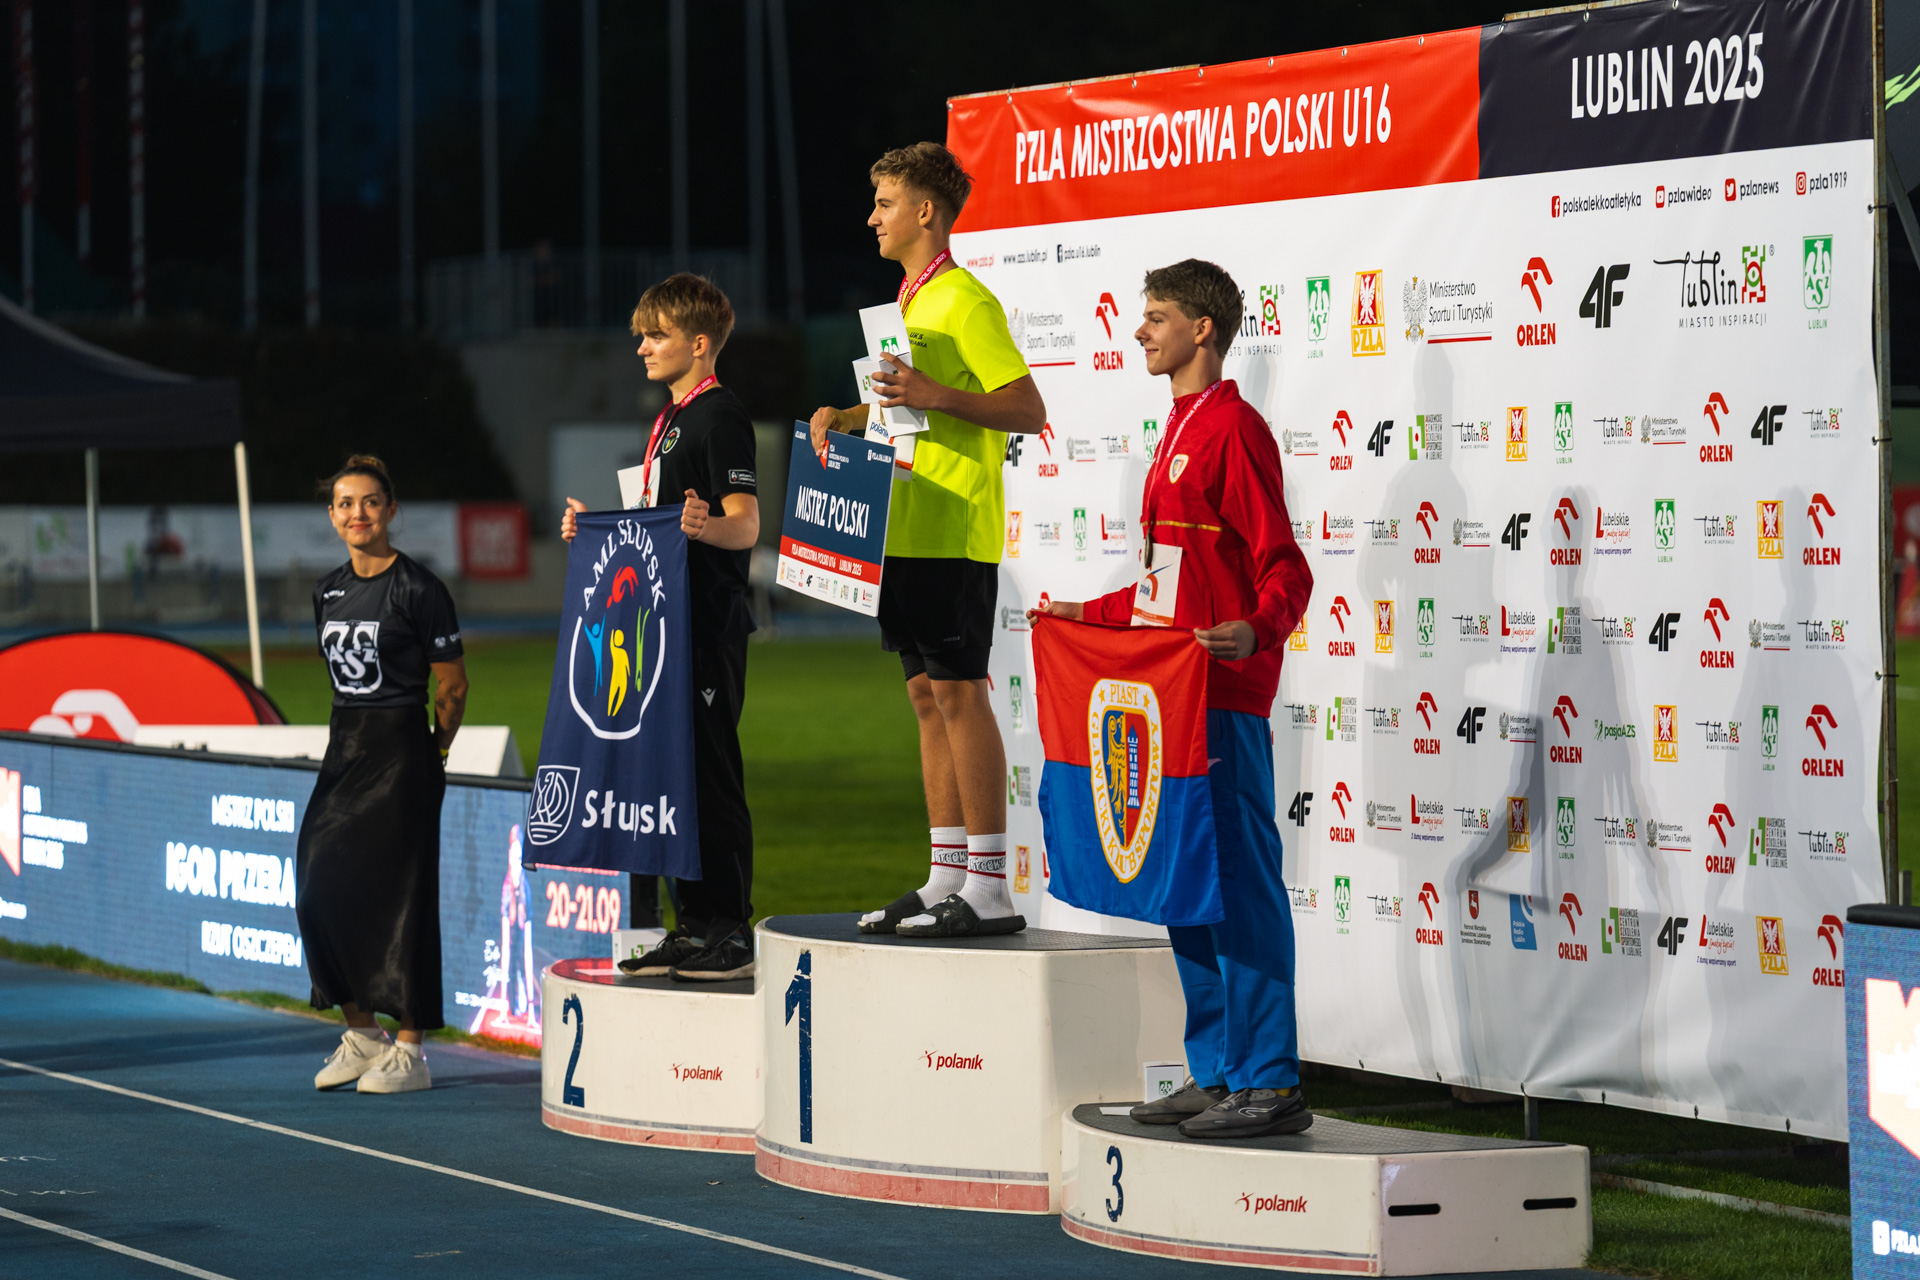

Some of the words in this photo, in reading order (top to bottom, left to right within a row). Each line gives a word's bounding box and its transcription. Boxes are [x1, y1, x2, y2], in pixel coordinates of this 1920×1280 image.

[1571, 45, 1673, 119] LUBLIN
[1685, 32, 1764, 106] 2025
[1016, 128, 1066, 184] PZLA
[1071, 105, 1236, 178] MISTRZOSTWA
[1245, 86, 1334, 158] POLSKI
[1342, 83, 1391, 147] U16
[1740, 179, 1779, 200] pzlanews
[1809, 172, 1847, 193] pzla1919
[1563, 191, 1641, 217] polskalekkoatletyka
[1668, 186, 1711, 207] pzlawideo
[918, 263, 936, 284] POLSKI
[935, 253, 946, 265] 2025
[1430, 281, 1475, 298] Ministerstwo
[1579, 264, 1630, 328] 4F
[1027, 313, 1063, 326] Ministerstwo
[1429, 306, 1450, 325] Sportu
[1457, 302, 1492, 323] Turystyki
[1679, 316, 1714, 328] MIASTO
[1720, 313, 1767, 326] INSPIRACJI
[1809, 319, 1827, 329] LUBLIN
[1027, 334, 1044, 350] Sportu
[1353, 328, 1383, 352] PZLA
[1517, 323, 1556, 346] ORLEN
[1245, 345, 1282, 356] INSPIRACJI
[1308, 350, 1323, 359] LUBLIN
[1094, 351, 1123, 370] ORLEN
[1193, 389, 1212, 410] POLSKI
[1751, 405, 1787, 445] 4F
[1367, 420, 1394, 457] 4F
[1507, 444, 1526, 458] PZLA
[1700, 445, 1732, 462] ORLEN
[1039, 464, 1058, 477] ORLEN
[1330, 455, 1353, 470] ORLEN
[795, 485, 828, 527] MISTRZ
[828, 495, 869, 538] POLSKI
[1501, 513, 1531, 550] 4F
[1415, 548, 1440, 563] ORLEN
[1550, 549, 1581, 565] ORLEN
[1759, 539, 1782, 556] PZLA
[1803, 548, 1840, 565] ORLEN
[584, 532, 617, 611] AML
[618, 519, 666, 611] SŁUPSK
[839, 559, 852, 572] LUBLIN
[852, 563, 862, 576] 2025
[1289, 634, 1307, 649] PZLA
[1649, 613, 1681, 651] 4F
[1328, 641, 1355, 656] ORLEN
[1376, 635, 1393, 650] PZLA
[1700, 650, 1734, 668] ORLEN
[1110, 684, 1139, 706] PIAST
[1457, 707, 1486, 743] 4F
[1604, 724, 1636, 740] pasjaAZS
[1414, 738, 1440, 754] ORLEN
[1550, 745, 1582, 763] ORLEN
[1655, 743, 1676, 759] PZLA
[1802, 758, 1844, 777] ORLEN
[1092, 711, 1113, 839] GLIWICKI
[1137, 720, 1159, 858] SPORTOWY
[212, 794, 253, 829] MISTRZ
[253, 798, 295, 833] POLSKI
[1288, 792, 1313, 827] 4F
[1330, 826, 1355, 842] ORLEN
[1509, 834, 1529, 849] PZLA
[1766, 828, 1786, 838] CENTRUM
[166, 841, 217, 898] IGOR
[1706, 855, 1735, 874] ORLEN
[546, 881, 621, 934] 20-21.09
[1416, 928, 1443, 945] ORLEN
[1658, 916, 1688, 955] 4F
[1558, 942, 1587, 961] ORLEN
[1761, 956, 1787, 972] PZLA
[562, 993, 584, 1108] 2
[785, 949, 812, 1144] 1
[936, 1052, 983, 1071] polanik
[682, 1065, 723, 1082] polanik
[1106, 1145, 1123, 1222] 3
[1255, 1194, 1307, 1214] polanik
